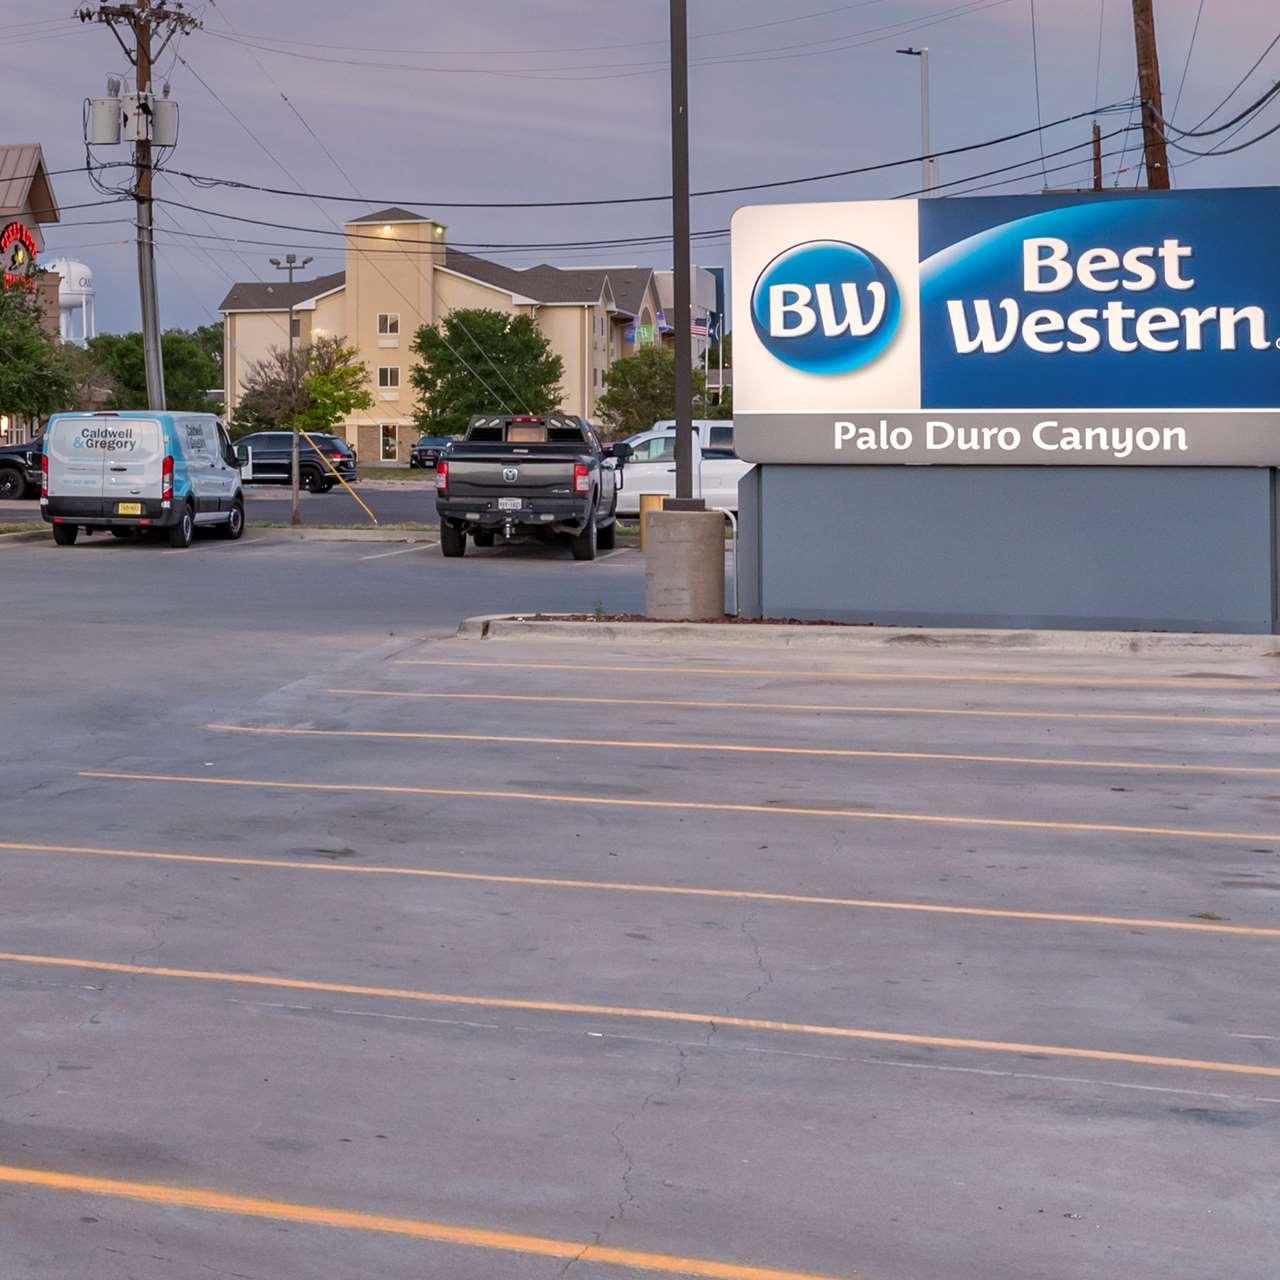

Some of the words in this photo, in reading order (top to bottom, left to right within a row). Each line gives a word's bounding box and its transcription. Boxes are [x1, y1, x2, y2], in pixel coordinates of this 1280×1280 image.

[1023, 237, 1194, 292] Best
[769, 281, 886, 338] BW
[947, 298, 1271, 354] Western
[73, 437, 84, 448] &
[86, 439, 136, 451] Gregory
[81, 428, 132, 438] Caldwell
[834, 420, 913, 451] Palo
[926, 420, 1022, 451] Duro
[1032, 420, 1189, 458] Canyon
